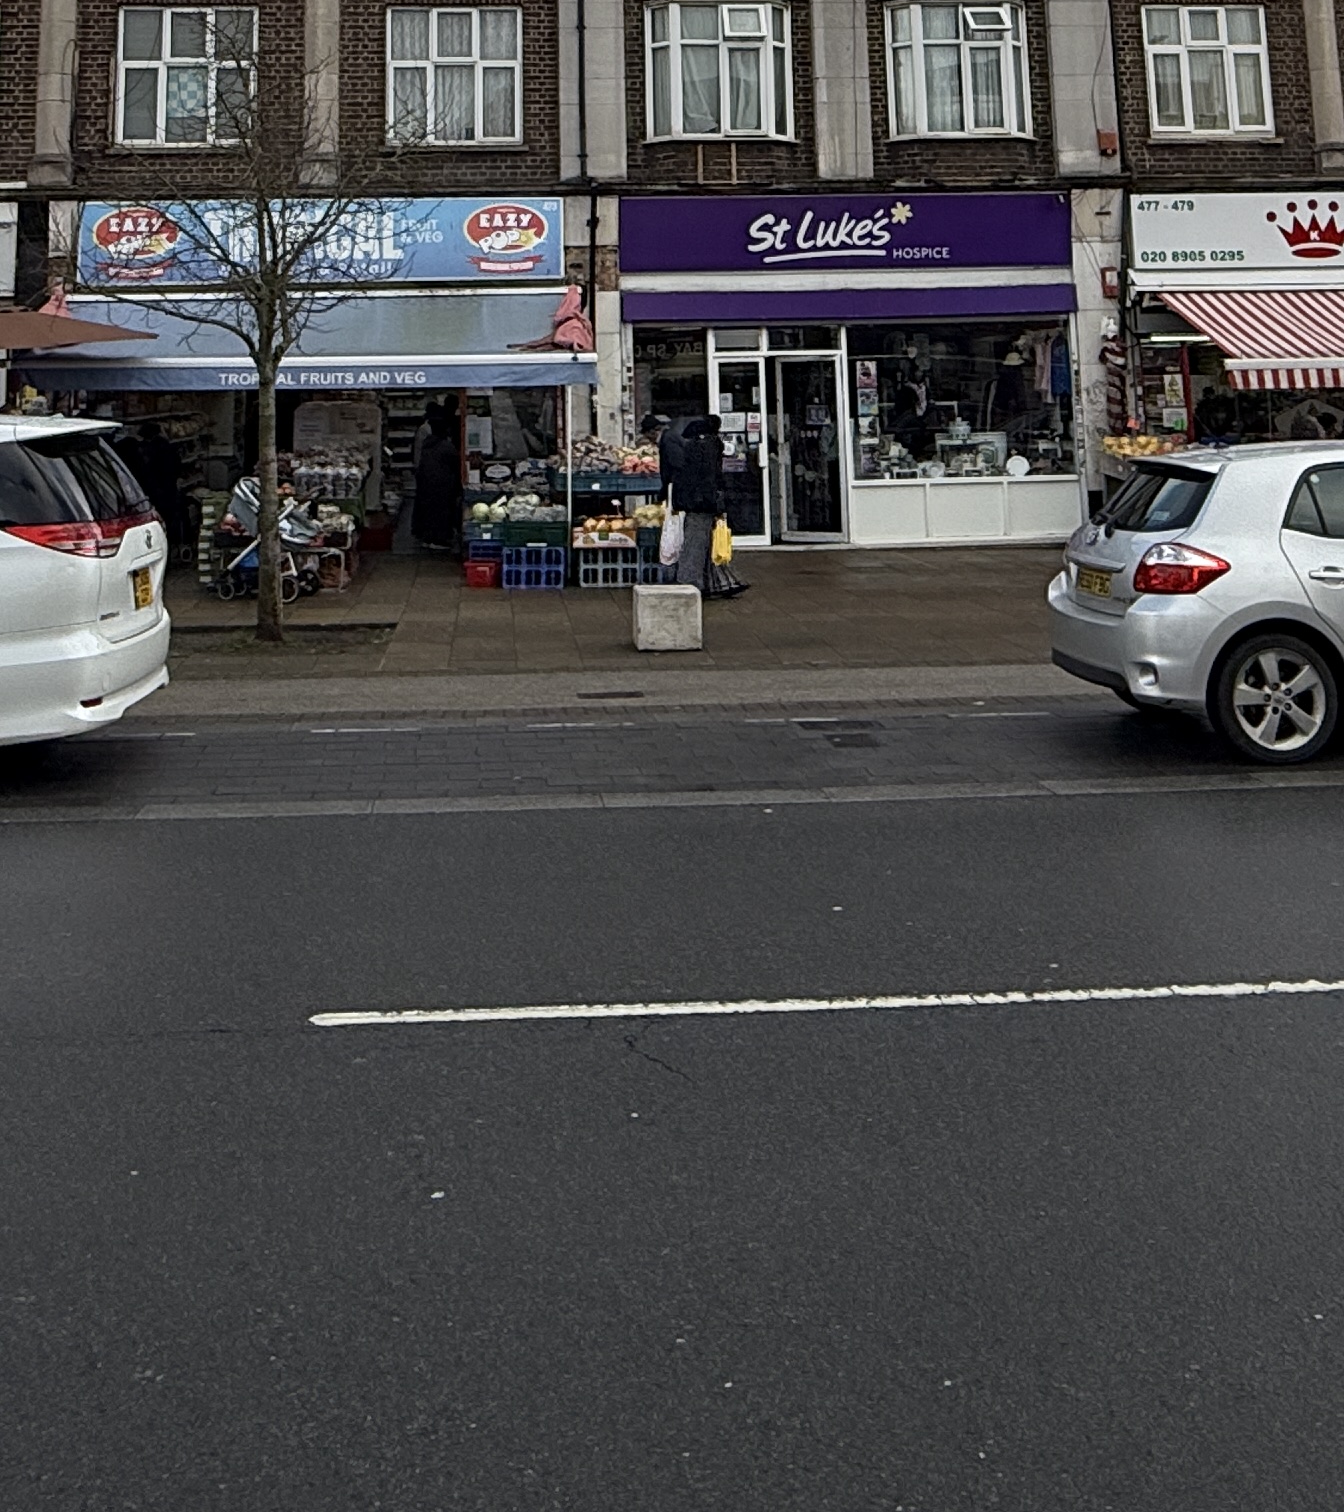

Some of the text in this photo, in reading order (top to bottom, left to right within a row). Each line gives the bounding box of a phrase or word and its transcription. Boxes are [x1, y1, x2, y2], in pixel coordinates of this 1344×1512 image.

[1137, 201, 1160, 211] 477
[1171, 200, 1194, 211] 479
[108, 217, 165, 232] EAZY
[400, 219, 439, 231] FRUIT
[479, 213, 532, 228] EAZY
[747, 208, 891, 252] St Luke's
[1309, 231, 1320, 241] K
[415, 231, 444, 243] VEG
[478, 230, 520, 254] POP
[893, 247, 950, 259] HOSPICE
[1141, 250, 1244, 262] 020 8905 0295
[219, 371, 426, 385] TROPAL FRUITS AND VEG
